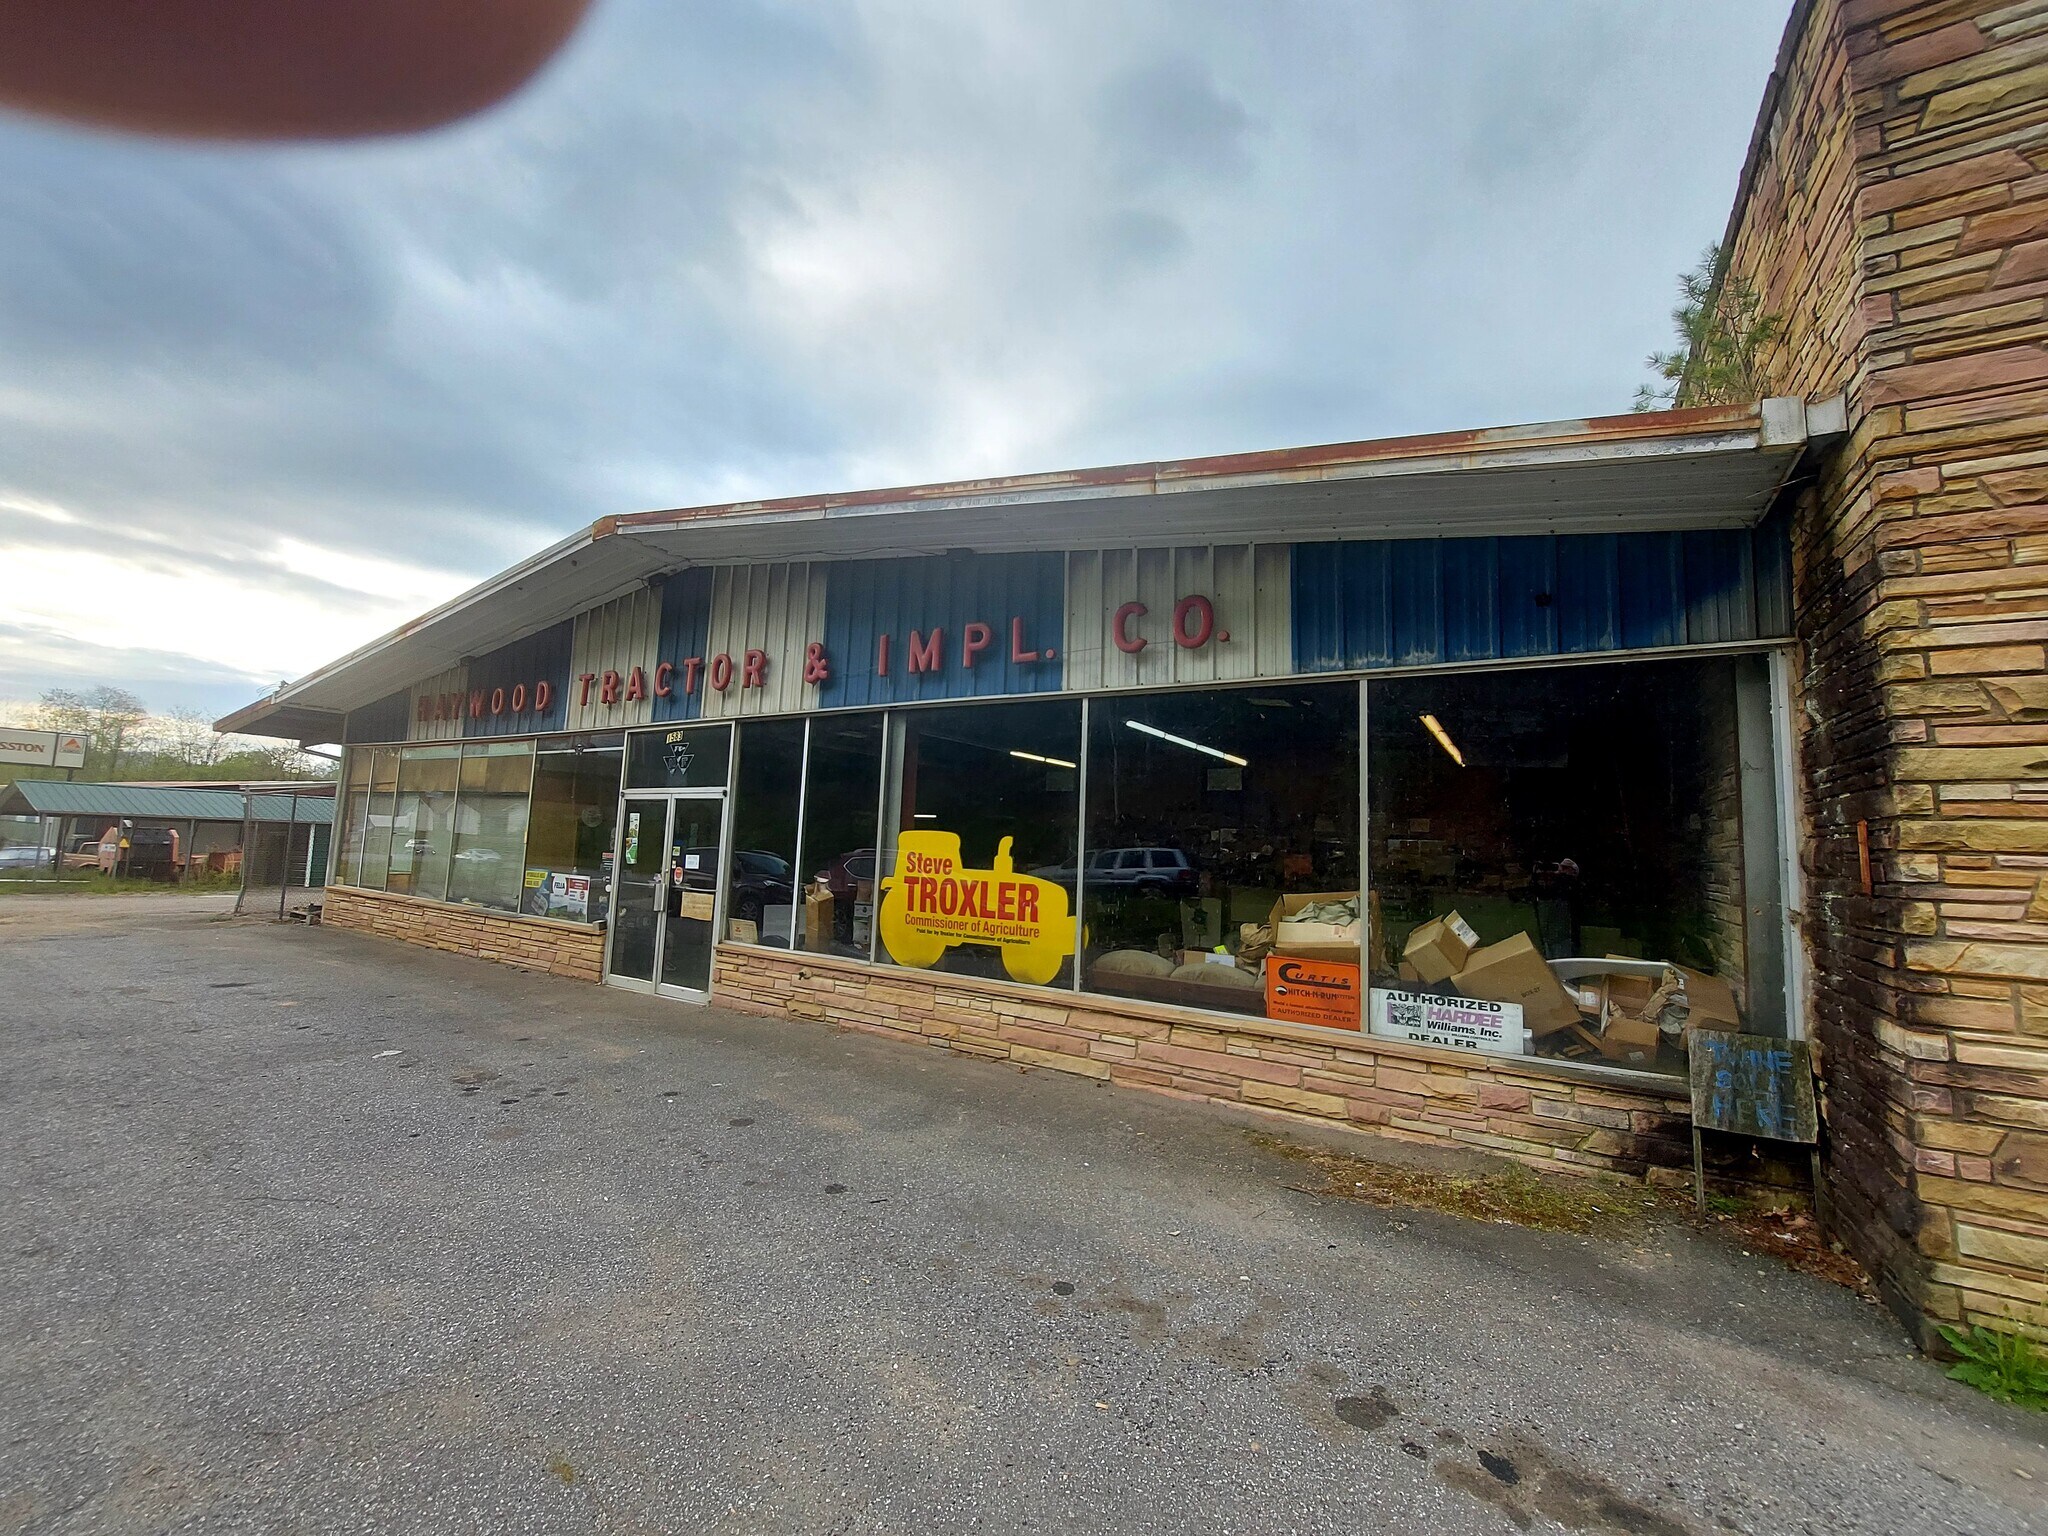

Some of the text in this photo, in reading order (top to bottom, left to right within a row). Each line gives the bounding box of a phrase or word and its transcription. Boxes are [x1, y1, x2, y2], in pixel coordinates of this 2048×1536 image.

[417, 594, 1231, 722] HAYWOOD TRACTOR & IMPL. CO.
[906, 851, 953, 875] Steve
[904, 876, 1040, 923] TROXLER
[905, 913, 1040, 938] Commissioner of Agriculture
[1278, 963, 1351, 990] CURTIS
[1386, 992, 1502, 1013] AUTHORIZED
[1277, 1007, 1321, 1019] AUTHORIZED
[1323, 1014, 1352, 1023] DEALER
[1426, 1006, 1504, 1028] HARDEE
[1480, 1027, 1503, 1038] Inc.
